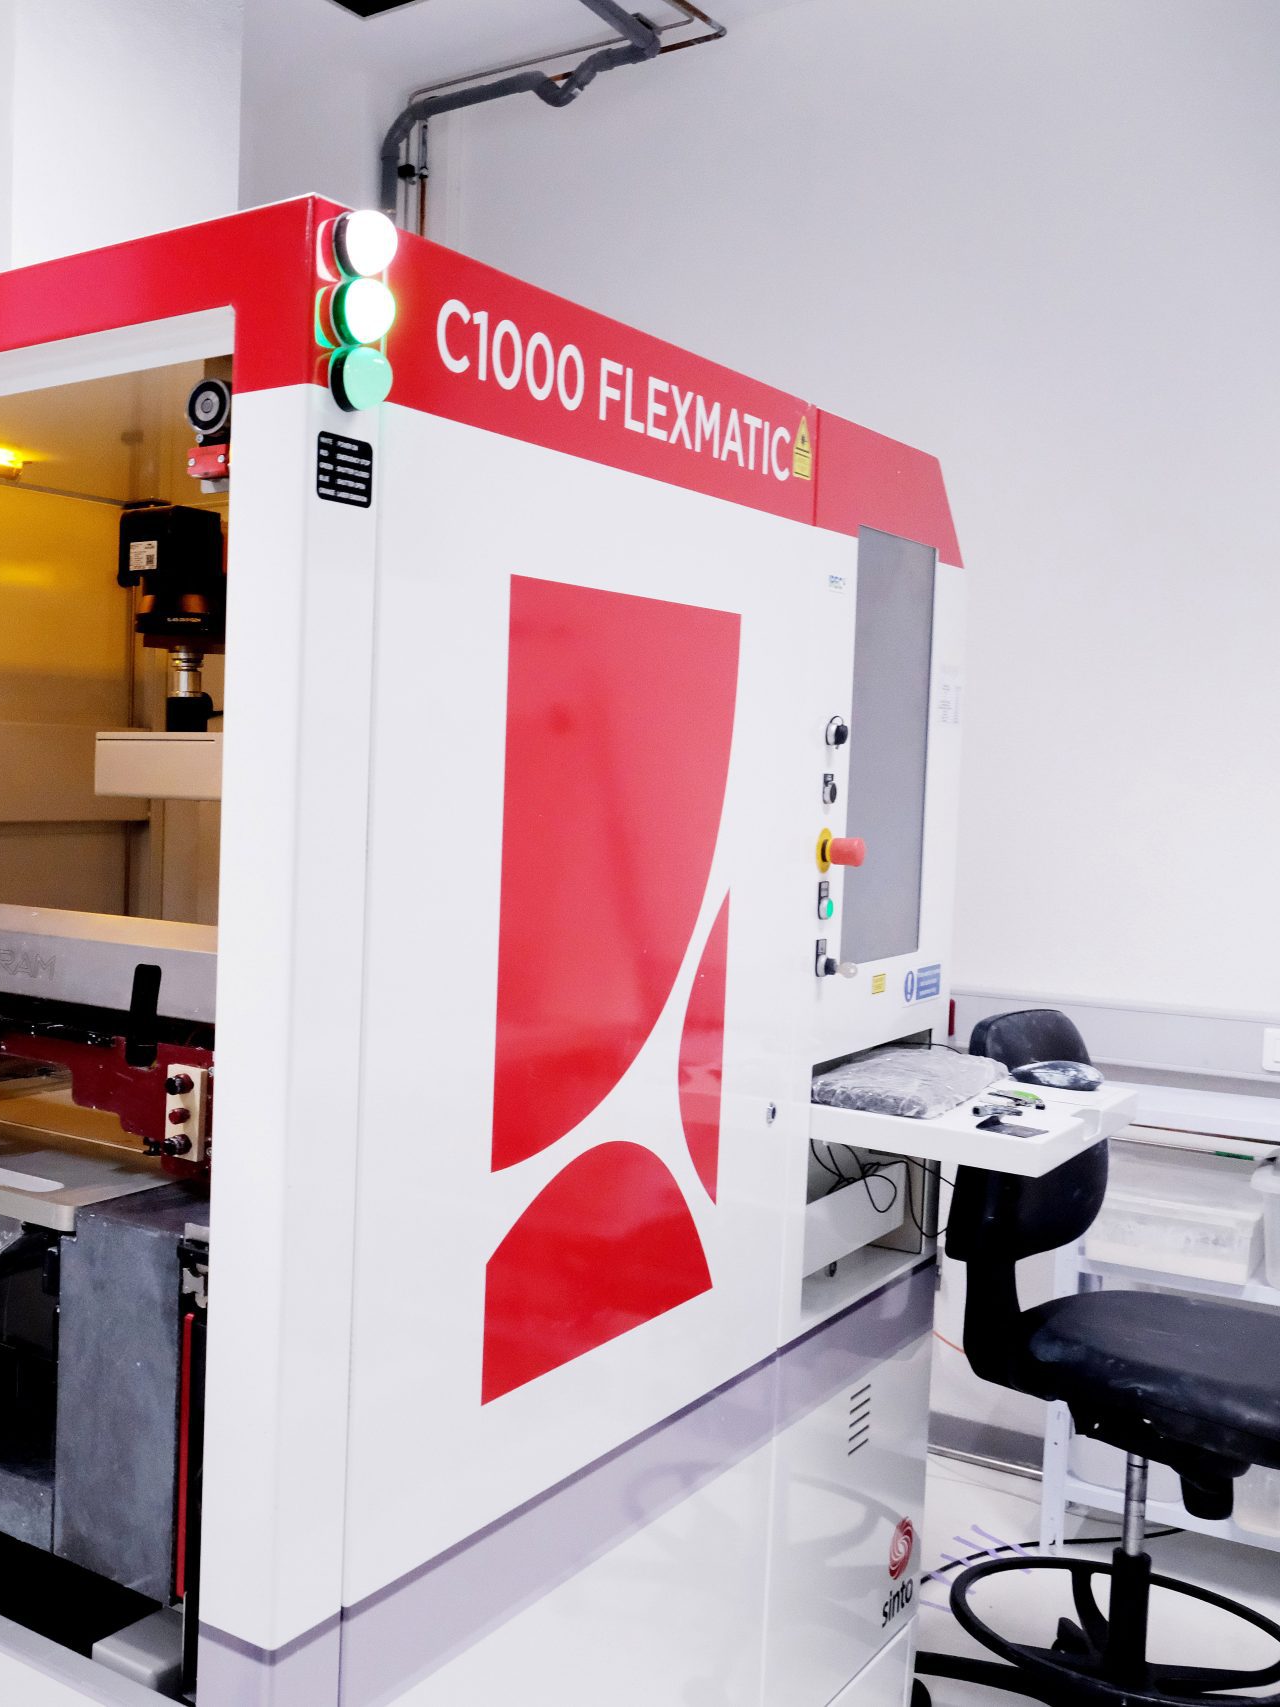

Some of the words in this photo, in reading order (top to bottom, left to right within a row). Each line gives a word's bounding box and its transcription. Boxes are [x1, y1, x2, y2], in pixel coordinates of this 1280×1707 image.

[436, 298, 585, 411] C1000
[598, 357, 791, 481] FLEXMATIC
[881, 1578, 914, 1628] sinto
